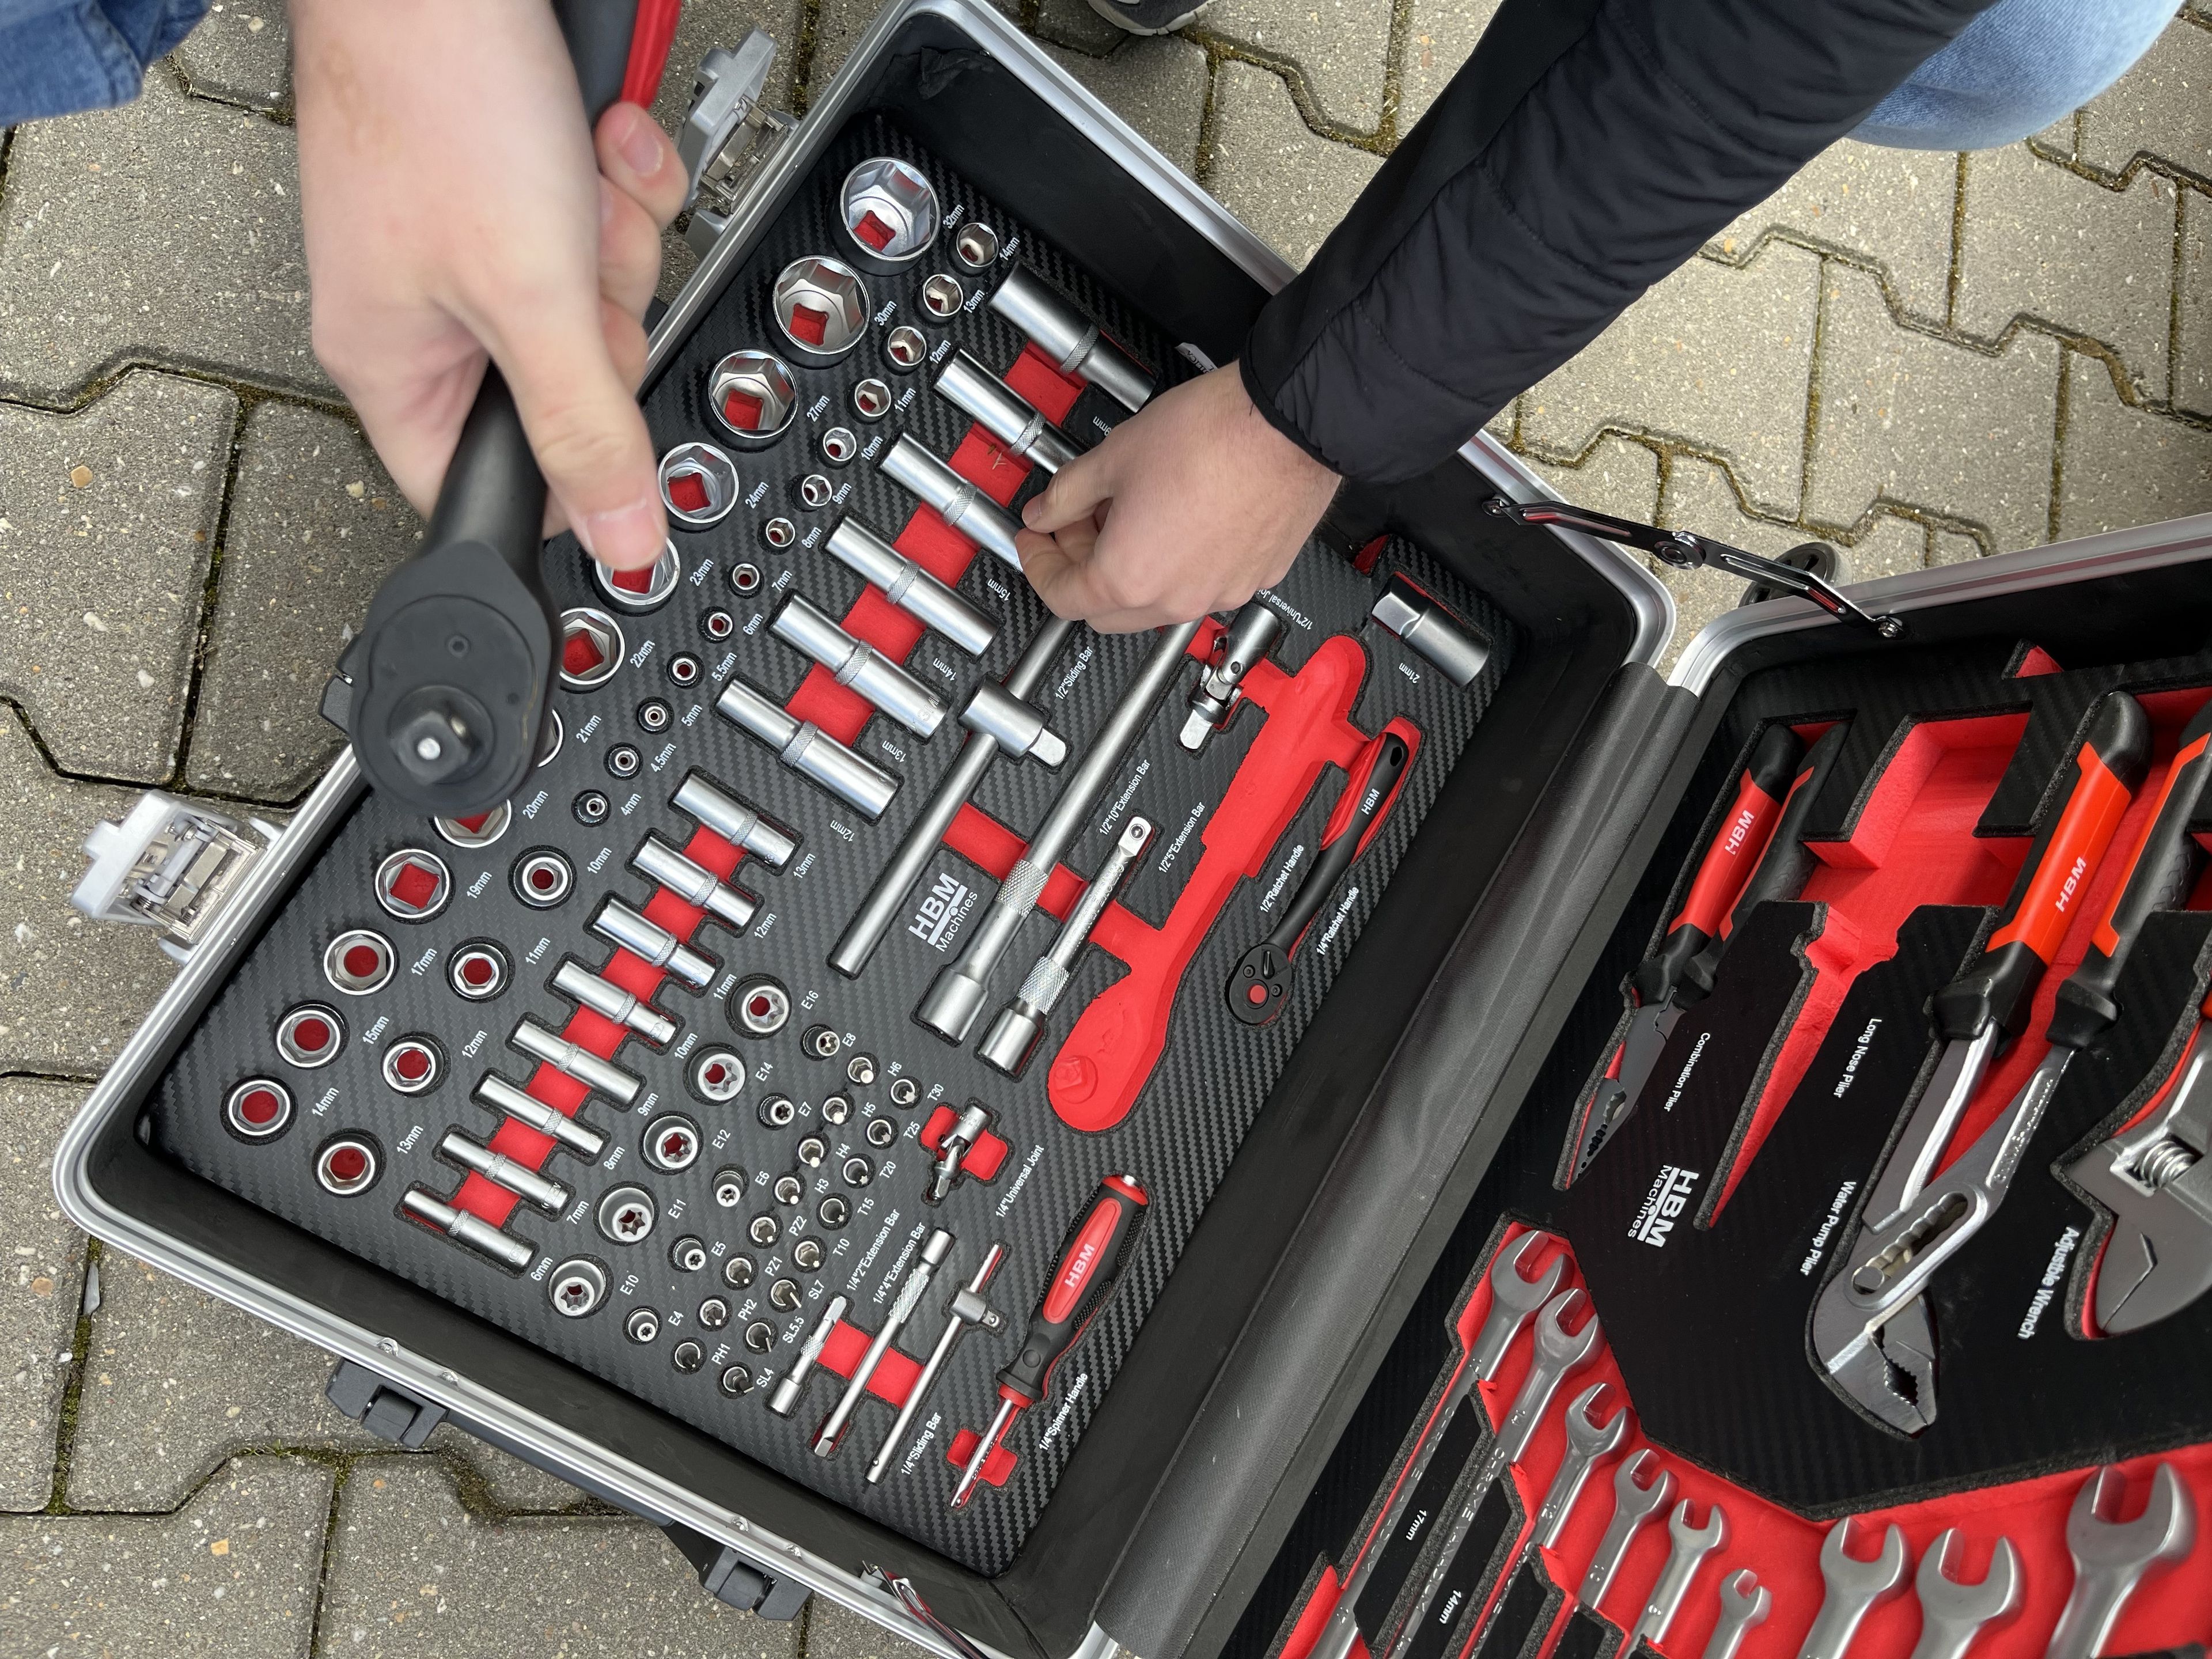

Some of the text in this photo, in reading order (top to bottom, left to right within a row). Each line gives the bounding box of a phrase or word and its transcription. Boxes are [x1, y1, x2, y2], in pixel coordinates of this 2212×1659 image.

[943, 204, 965, 229] 32mm
[999, 237, 1020, 261] 14mm
[963, 289, 986, 313] 13mm
[874, 300, 897, 328] 30mm
[929, 339, 951, 364] 12mm
[806, 395, 830, 422] 27mm
[895, 387, 916, 412] 11mm
[1093, 416, 1111, 436] 9mm
[861, 435, 883, 461] 10mm
[745, 481, 769, 509] 24mm
[832, 482, 852, 505] 9mm
[801, 526, 822, 549] 8mm
[690, 558, 714, 587] 23mm
[771, 570, 793, 594] 7mm
[987, 578, 1012, 602] 15mm
[743, 612, 764, 636] 6mm
[630, 639, 656, 669] 22mm
[711, 651, 737, 682] 5.5mm
[1079, 646, 1093, 662] Bar
[933, 657, 959, 682] 14mm
[1399, 662, 1421, 684] 21mm
[681, 703, 703, 727] 5mm
[576, 714, 602, 744] 21mm
[650, 743, 677, 774] 4.5mm
[882, 740, 907, 763] 13mm
[1139, 759, 1152, 778] Bar
[522, 790, 549, 820] 20mm
[620, 793, 642, 816] 4mm
[1192, 801, 1206, 820] Bar
[1361, 789, 1380, 816] HBM
[830, 819, 855, 843] 12mm
[1725, 809, 1755, 855] HBM
[587, 847, 612, 875] 10mm
[793, 853, 816, 880] 13mm
[1283, 844, 1304, 871] Handle
[466, 871, 493, 900] 19mm
[2055, 857, 2087, 912] HBM
[908, 872, 960, 940] HBM
[1339, 887, 1359, 913] Handle
[753, 912, 777, 940] 12mm
[935, 891, 978, 952] Machines
[411, 948, 438, 976] 17mm
[525, 936, 551, 966] 11mm
[713, 974, 737, 1001] 11mm
[801, 990, 819, 1010] E16
[362, 1016, 390, 1045] 15mm
[842, 1032, 857, 1048] E8
[461, 1029, 488, 1059] 12mm
[674, 1032, 698, 1060] 10mm
[888, 1061, 902, 1077] H6
[1834, 1017, 1883, 1099] Long Nose Plier
[755, 1062, 774, 1082] E14
[1664, 1032, 1711, 1112] Combination Plier
[312, 1086, 339, 1117] 14mm
[637, 1093, 660, 1117] 9mm
[927, 1084, 944, 1101] T30
[798, 1101, 813, 1118] E7
[861, 1103, 876, 1118] H5
[396, 1125, 424, 1154] 13mm
[712, 1129, 731, 1149] E12
[903, 1121, 921, 1139] T25
[604, 1146, 626, 1171] 8mm
[836, 1143, 851, 1158] H4
[1028, 1144, 1044, 1168] Joint
[755, 1171, 770, 1186] E6
[879, 1161, 897, 1179] T20
[814, 1178, 830, 1194] H3
[566, 1200, 590, 1225] 7mm
[668, 1199, 686, 1219] E11
[857, 1198, 874, 1217] T15
[1627, 1164, 1672, 1238] Machines
[1645, 1169, 1699, 1248] HBM
[789, 1215, 807, 1236] PZ2
[885, 1209, 900, 1228] Bar
[911, 1222, 926, 1240] Bar
[1800, 1181, 1857, 1276] Water Pump Plier
[711, 1241, 726, 1257] E5
[833, 1238, 850, 1257] T10
[530, 1256, 554, 1282] 6mm
[764, 1256, 783, 1277] PZ1
[1065, 1243, 1095, 1287] HBM
[620, 1274, 639, 1296] E10
[808, 1279, 825, 1300] SL7
[668, 1310, 684, 1326] E4
[737, 1298, 757, 1320] PH2
[2017, 1289, 2054, 1340] Wrench
[782, 1316, 805, 1343] SL5.5
[711, 1343, 731, 1365] PH1
[756, 1368, 774, 1388] SL4
[1065, 1373, 1088, 1403] Handle
[926, 1412, 942, 1430] Bar
[1406, 1509, 1427, 1541] 17mm
[1439, 1590, 1463, 1624] 14mm
